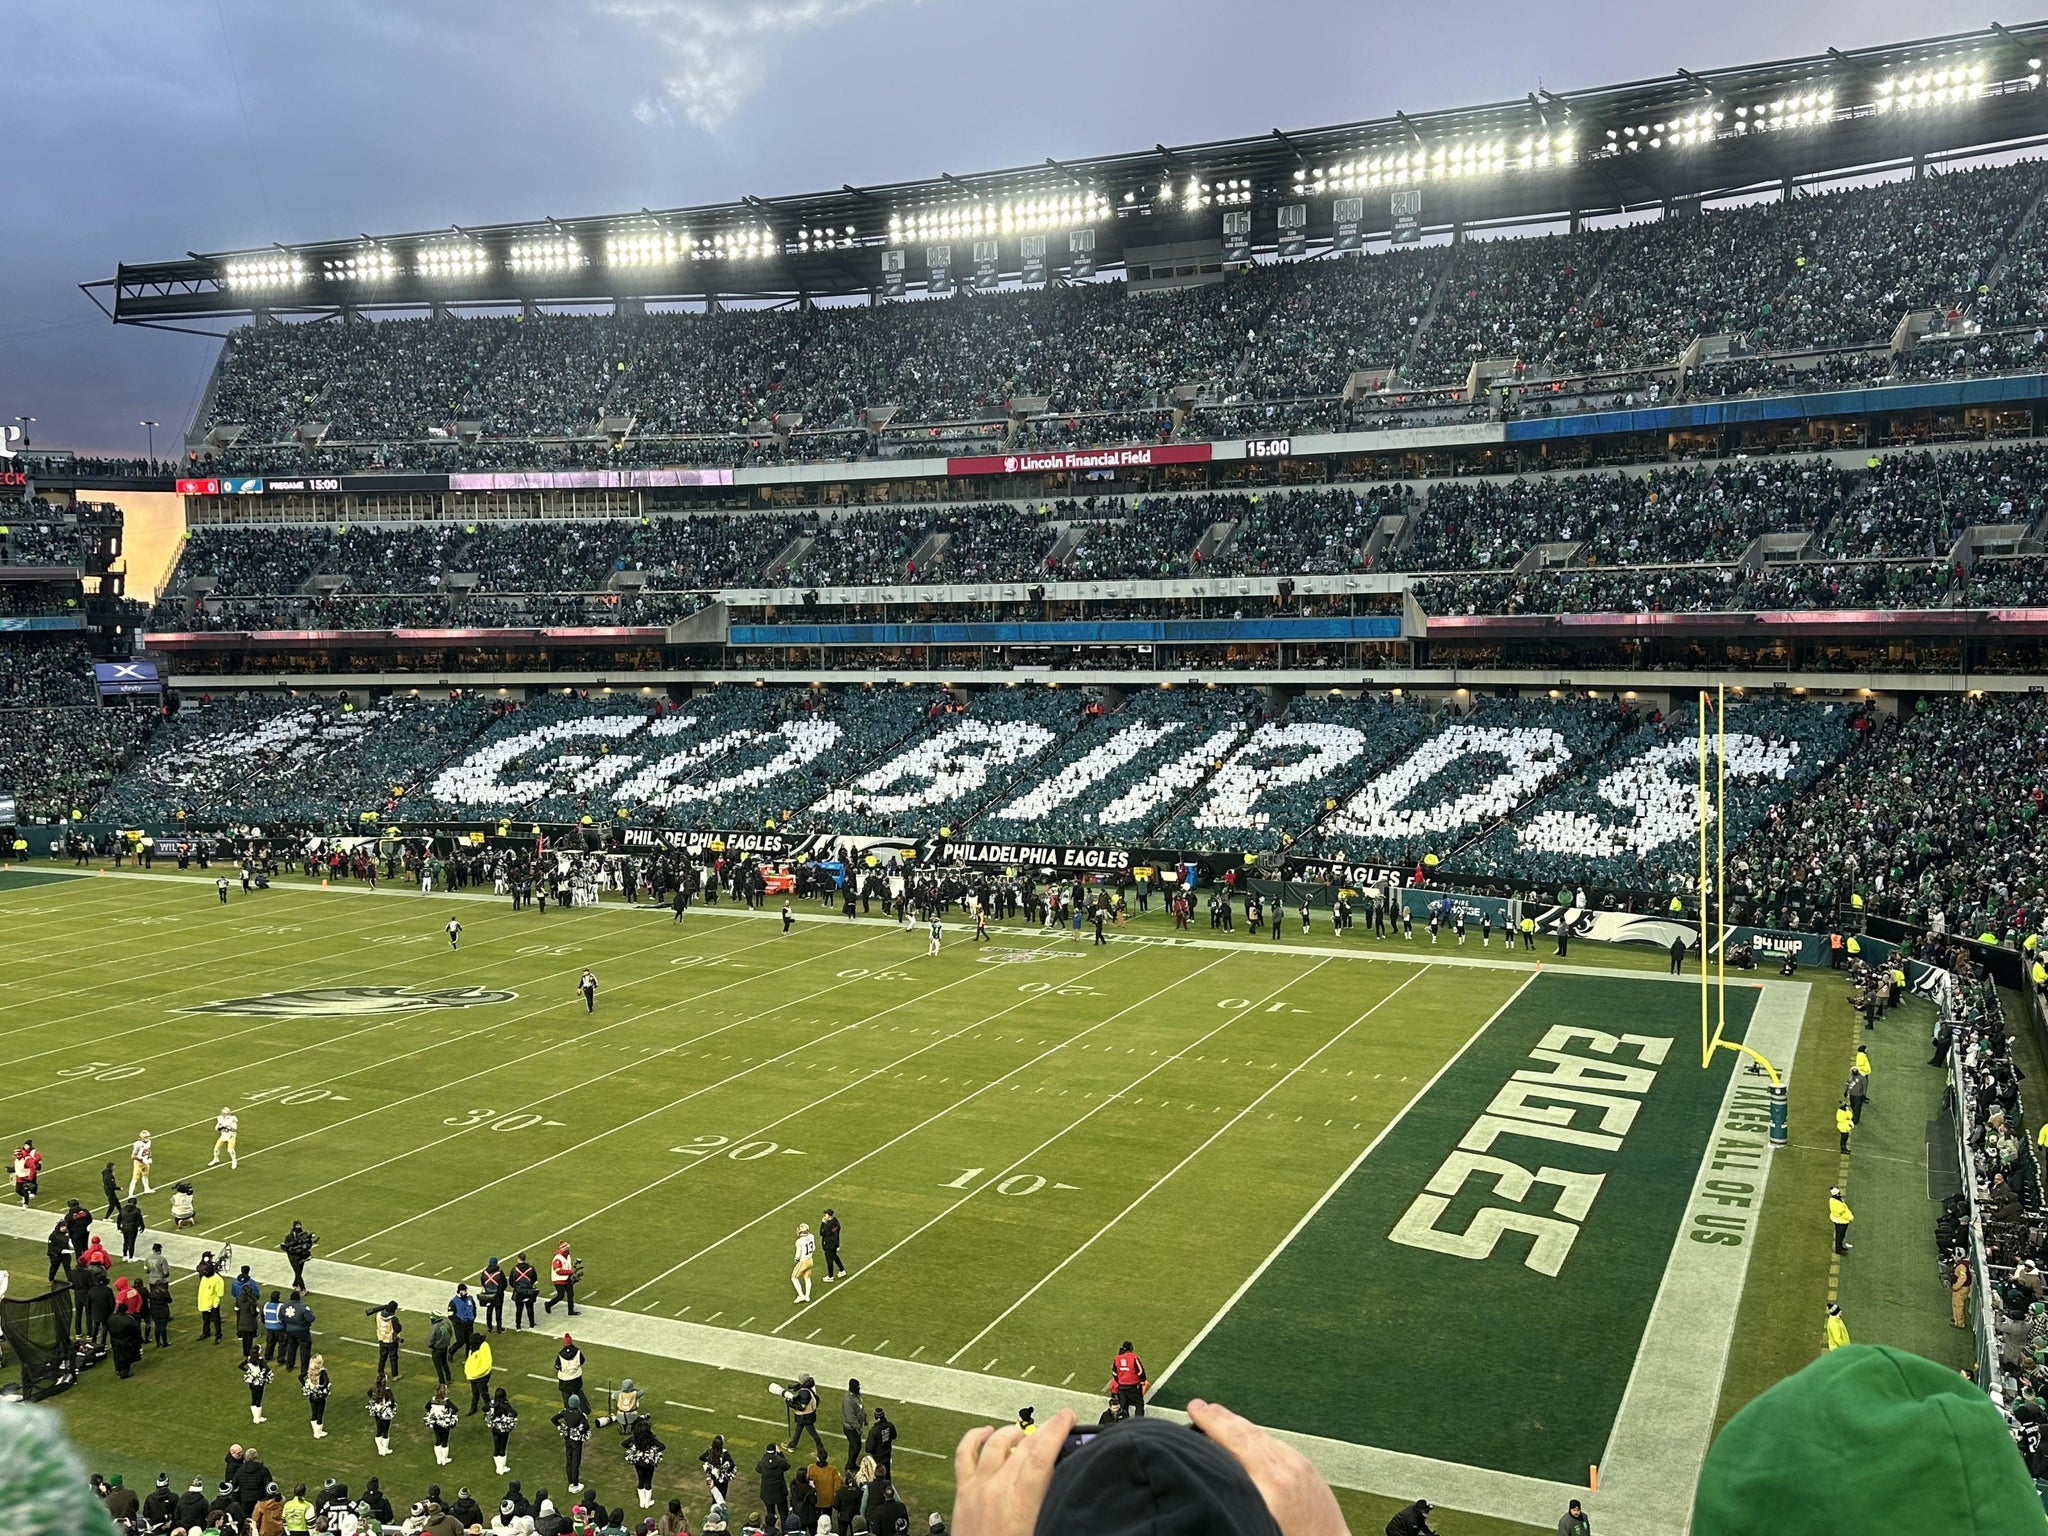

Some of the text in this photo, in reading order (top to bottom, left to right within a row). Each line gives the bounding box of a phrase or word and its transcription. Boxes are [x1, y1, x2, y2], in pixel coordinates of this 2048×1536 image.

[1336, 199, 1360, 223] 99
[1394, 192, 1418, 216] 20
[1226, 214, 1248, 236] 15
[1280, 206, 1303, 230] 40
[1023, 236, 1044, 258] 60
[1072, 232, 1093, 252] 70
[888, 252, 898, 272] 5
[976, 242, 996, 263] 44
[1247, 439, 1289, 457] 15:00
[1021, 450, 1151, 470] Lincoln Financial Field
[208, 482, 214, 492] 0
[224, 482, 232, 492] 0
[270, 482, 304, 490] PREGAME
[309, 480, 338, 490] 15:00
[120, 684, 143, 692] xfinity
[727, 834, 782, 852] EAGLES
[944, 844, 1129, 869] PHILADELPHIA EAGLES
[1331, 865, 1400, 888] EAGLES
[516, 944, 583, 956] 50
[1753, 934, 1772, 950] 94
[1018, 982, 1095, 996] 20
[1218, 998, 1294, 1012] 10
[57, 1062, 146, 1081] 50
[240, 1086, 332, 1105] 40
[443, 1108, 543, 1132] 30
[669, 1134, 779, 1162] 20
[1388, 1024, 1675, 1278] EAGLES
[1709, 1137, 1767, 1170] ALL
[938, 1166, 1047, 1196] 10
[1701, 1180, 1755, 1210] OF
[1690, 1214, 1746, 1247] US
[806, 1242, 814, 1256] 13
